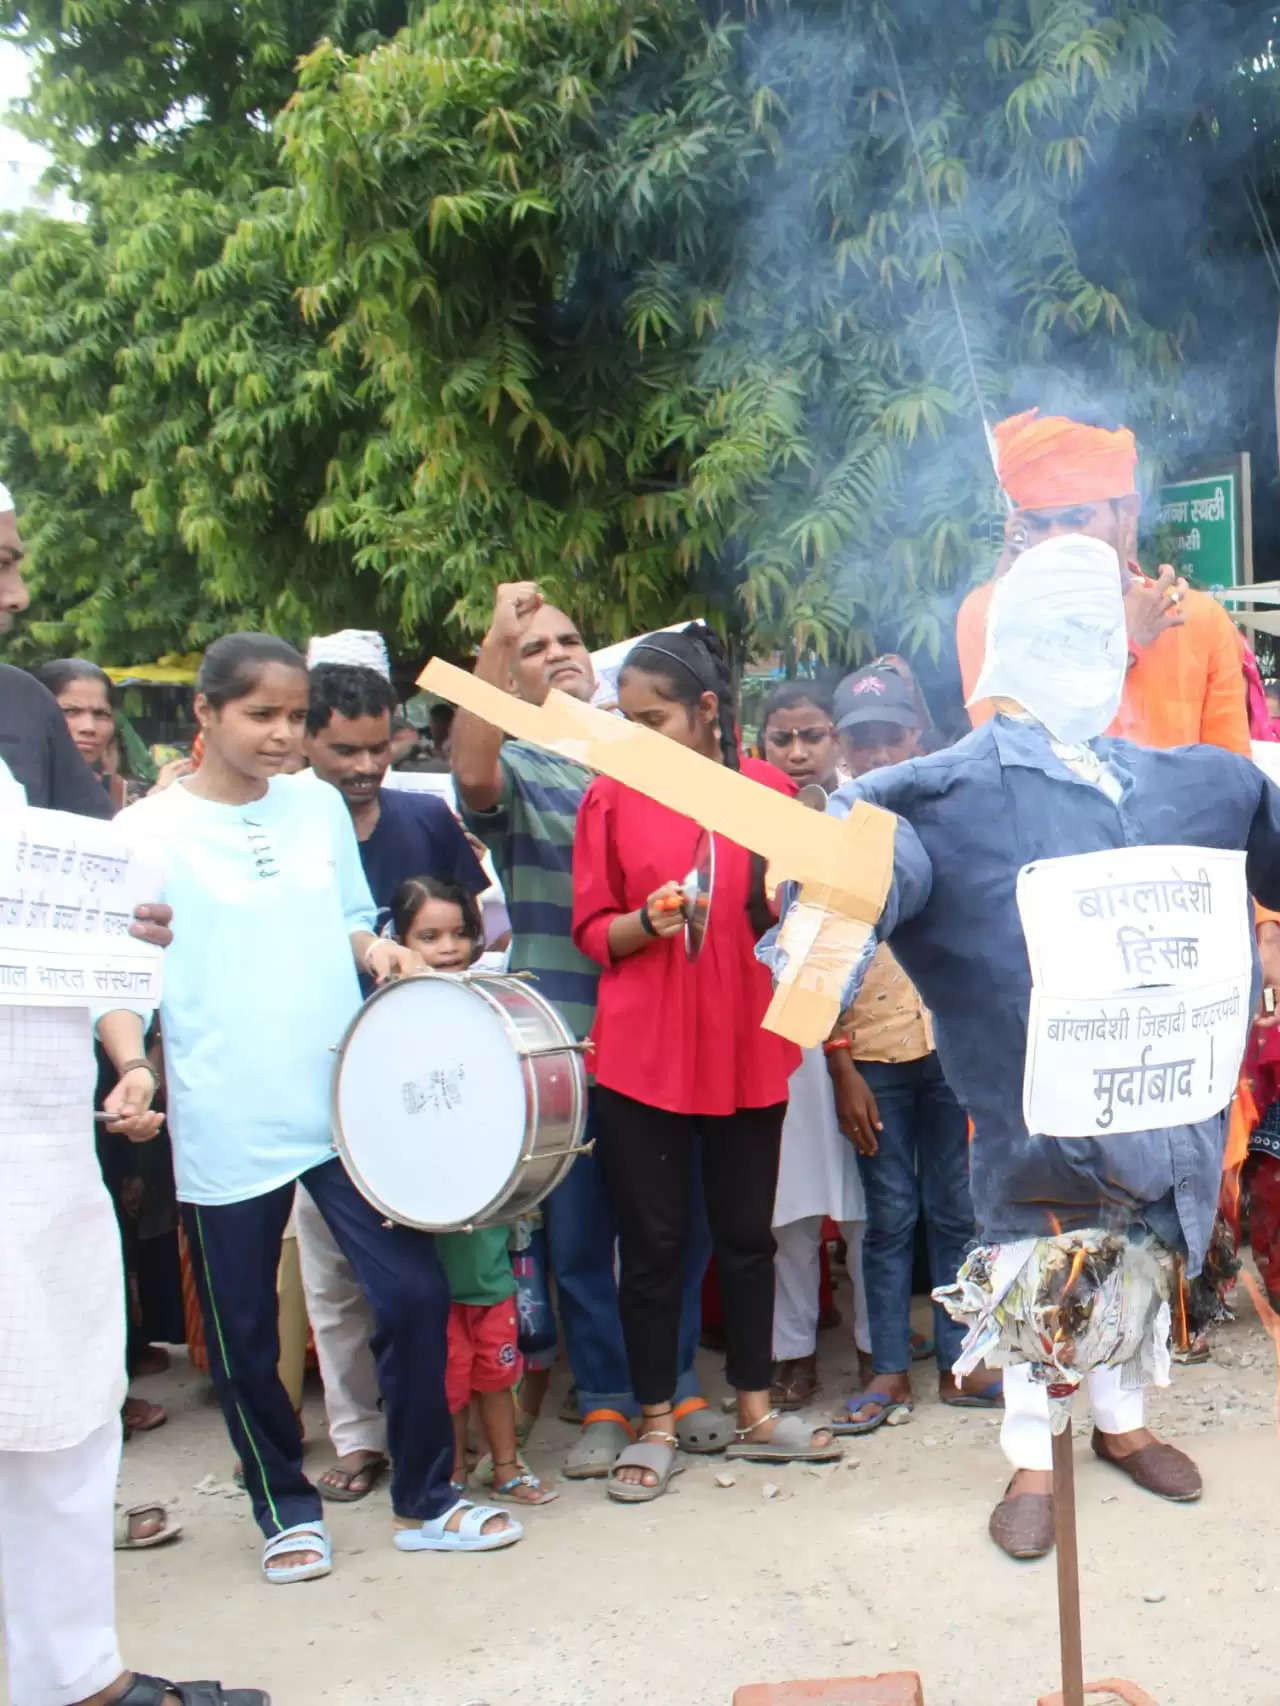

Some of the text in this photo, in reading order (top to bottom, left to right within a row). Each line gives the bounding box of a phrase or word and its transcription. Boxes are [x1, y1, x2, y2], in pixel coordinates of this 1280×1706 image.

[1190, 486, 1225, 523] स्थली
[1072, 865, 1213, 919] बांग्लादेशी
[1115, 924, 1200, 975] हिंसक
[36, 964, 85, 989] भारत
[93, 963, 153, 990] संस्थान
[1047, 1007, 1130, 1042] बांग्लादेशी
[1136, 1001, 1187, 1038] जिहादी
[1093, 1035, 1215, 1128] मुर्दाबाद !
